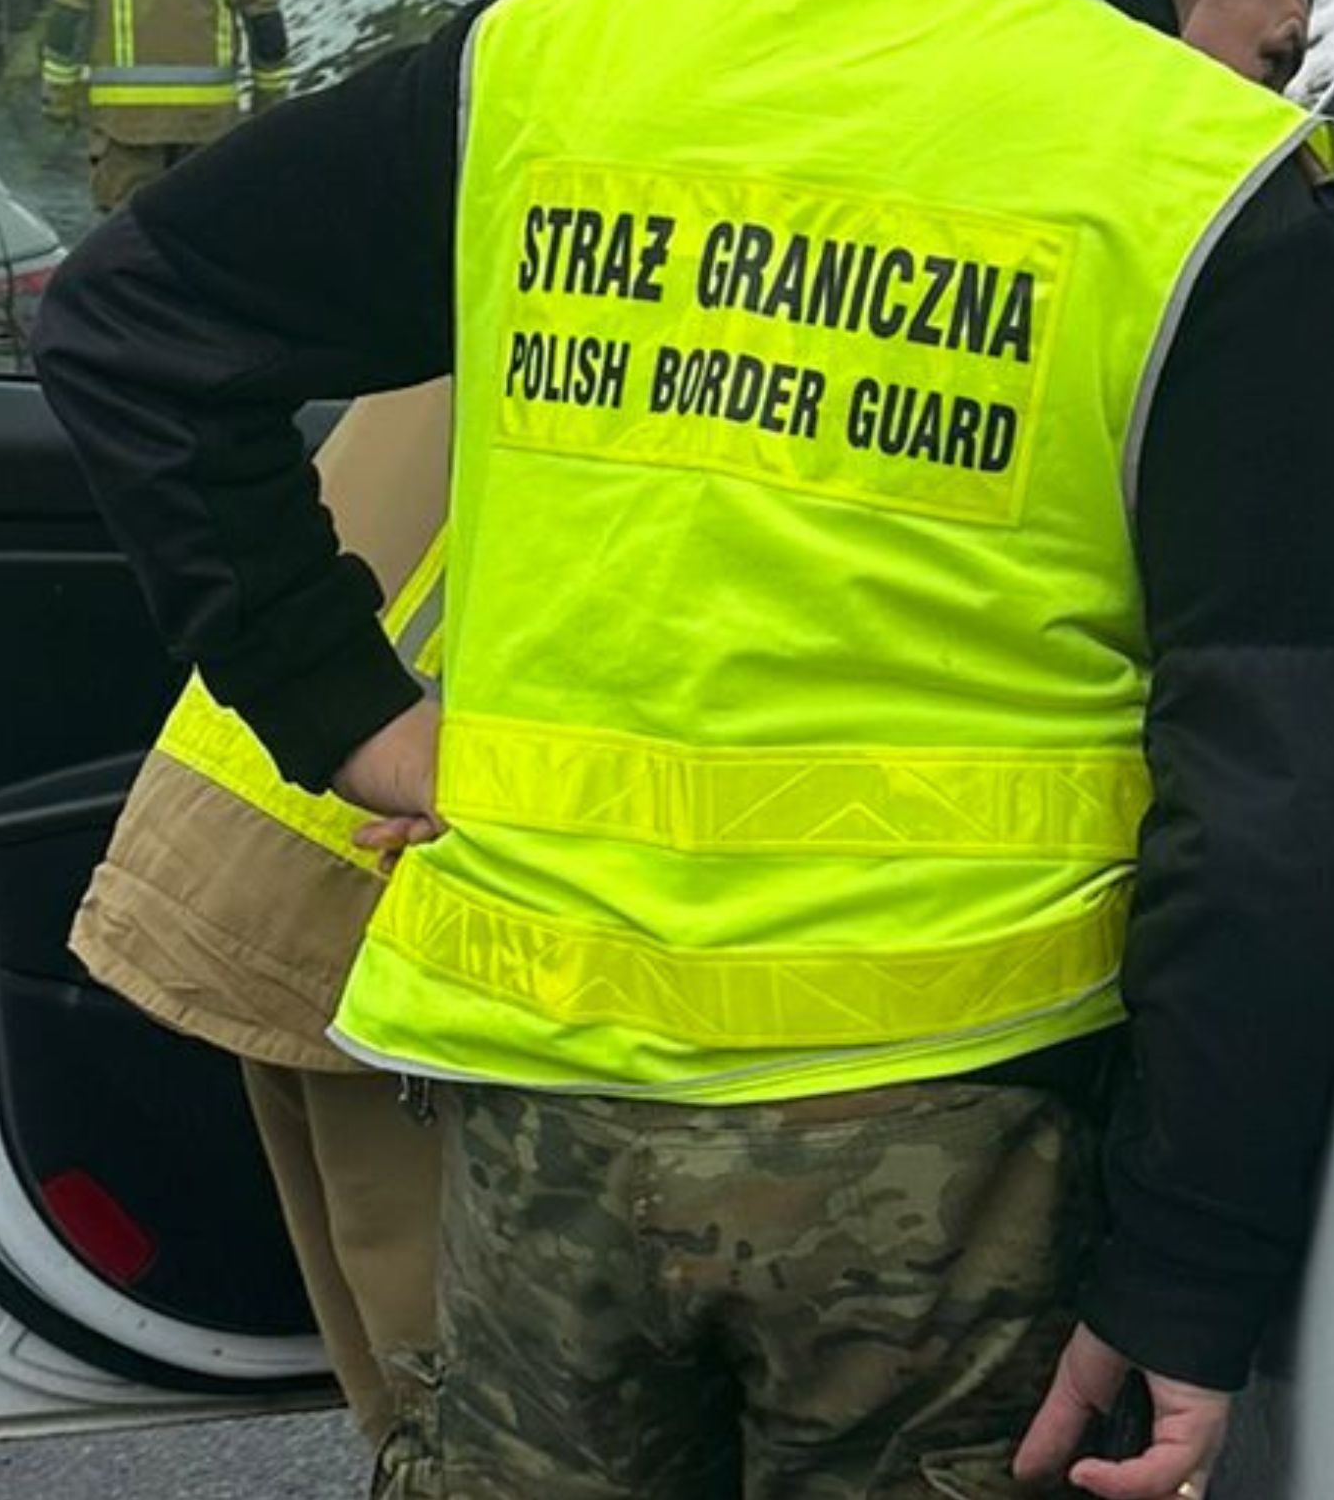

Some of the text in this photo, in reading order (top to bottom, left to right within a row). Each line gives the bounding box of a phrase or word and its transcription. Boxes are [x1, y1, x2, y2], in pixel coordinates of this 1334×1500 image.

[517, 204, 1036, 363] STRAŻ GRANICZNA
[505, 330, 1019, 475] POLISH BORDER GUARD
